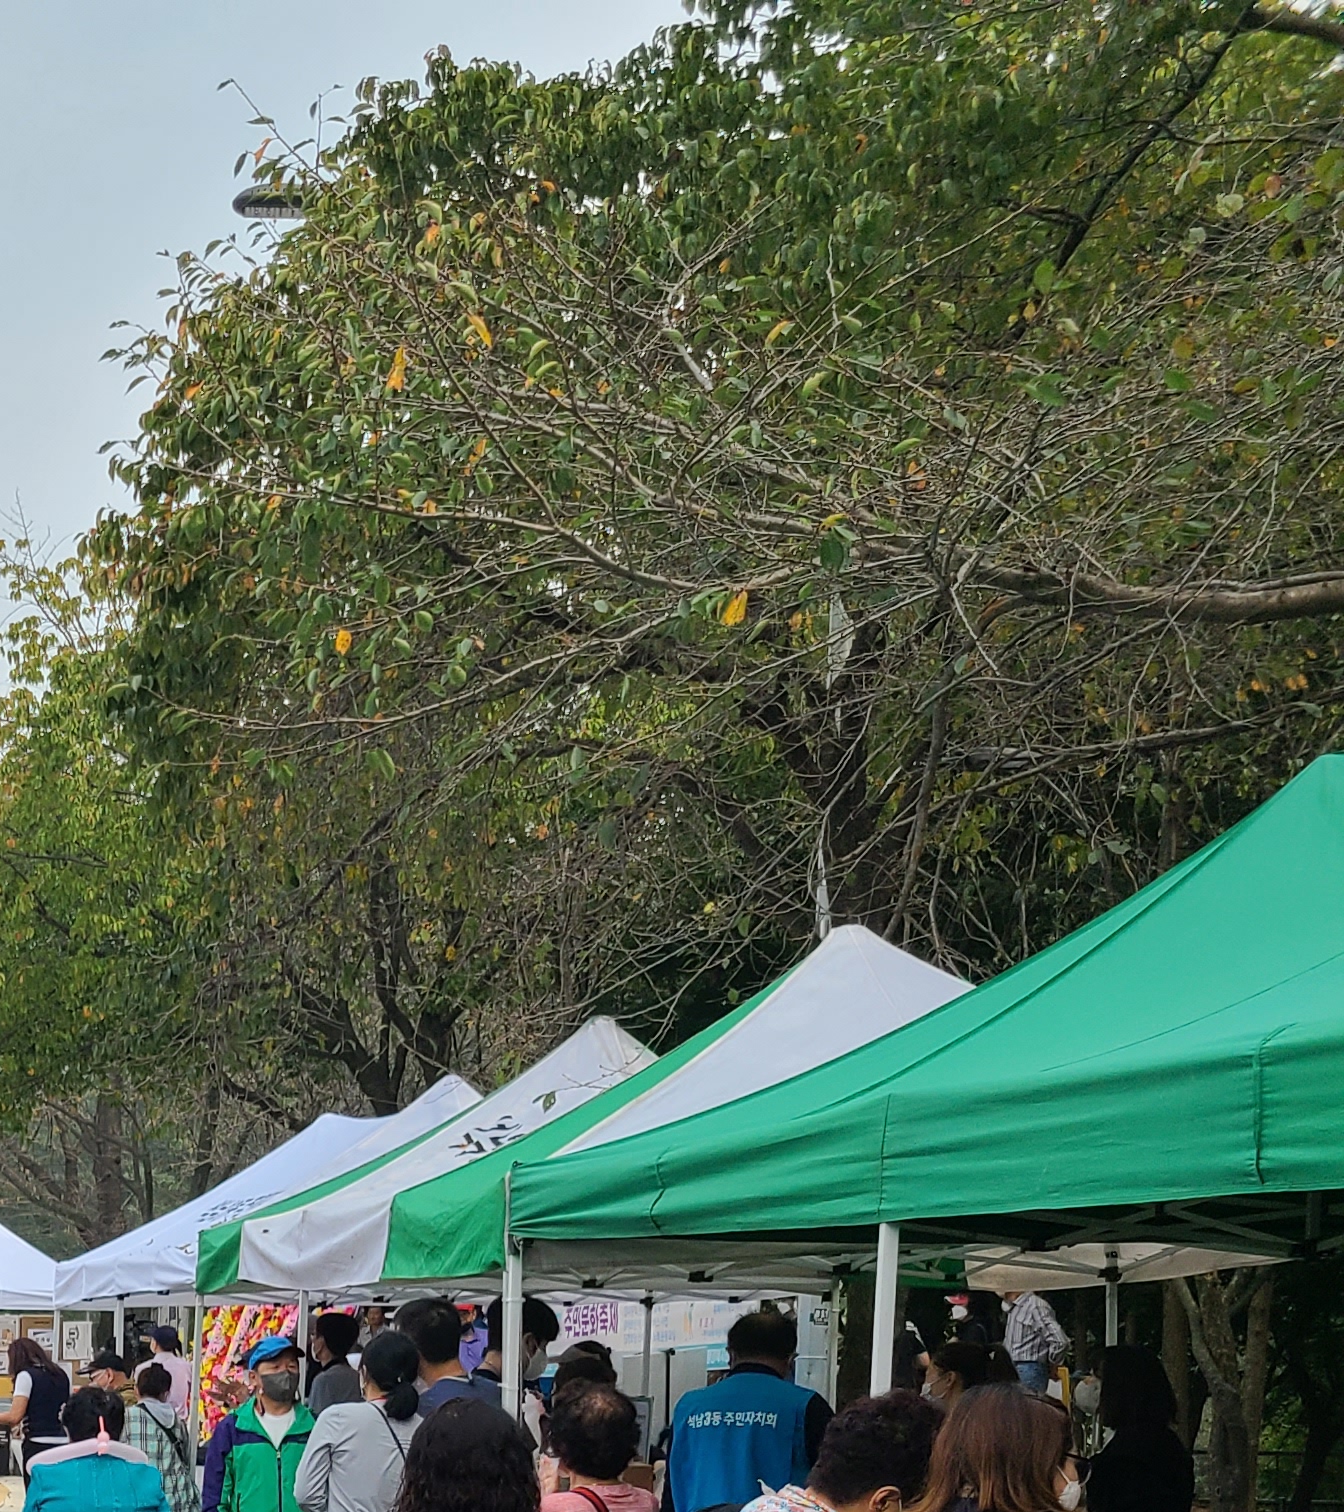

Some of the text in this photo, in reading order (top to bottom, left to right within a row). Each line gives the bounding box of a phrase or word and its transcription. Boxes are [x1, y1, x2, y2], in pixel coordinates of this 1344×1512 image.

[564, 1302, 619, 1339] 주민문화축제
[687, 1411, 778, 1429] 석남3동 주민자치회
